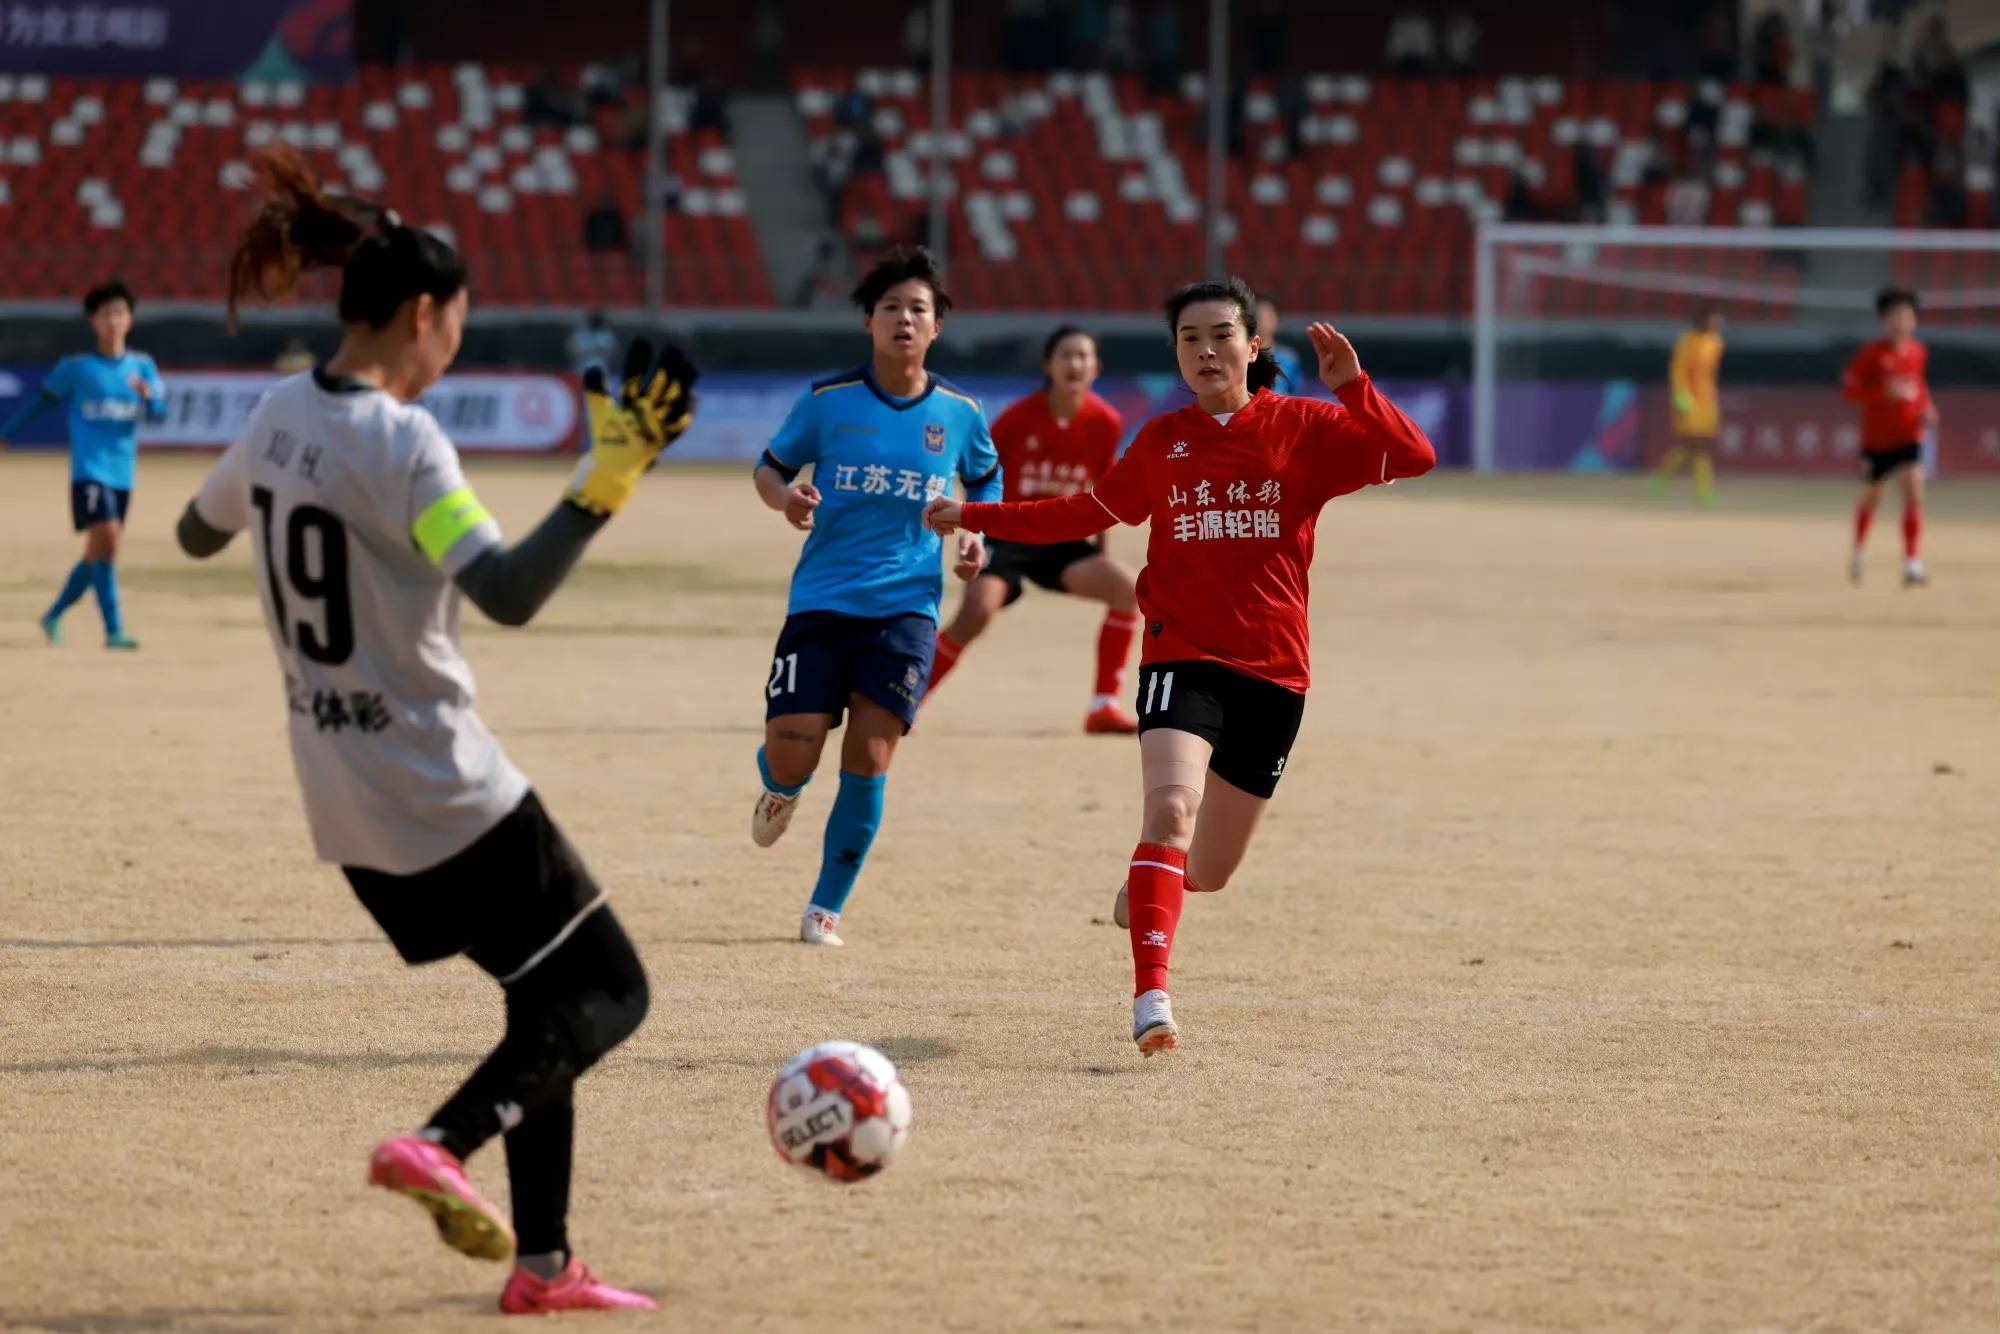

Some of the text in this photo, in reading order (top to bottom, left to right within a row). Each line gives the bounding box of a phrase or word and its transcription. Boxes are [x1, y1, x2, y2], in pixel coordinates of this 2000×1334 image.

[1166, 452, 1191, 460] KELME
[1173, 509, 1281, 542] 丰源轮胎
[252, 486, 354, 666] 19
[769, 652, 798, 699] 21
[1145, 671, 1175, 715] 11
[780, 1104, 844, 1148] SELECT
